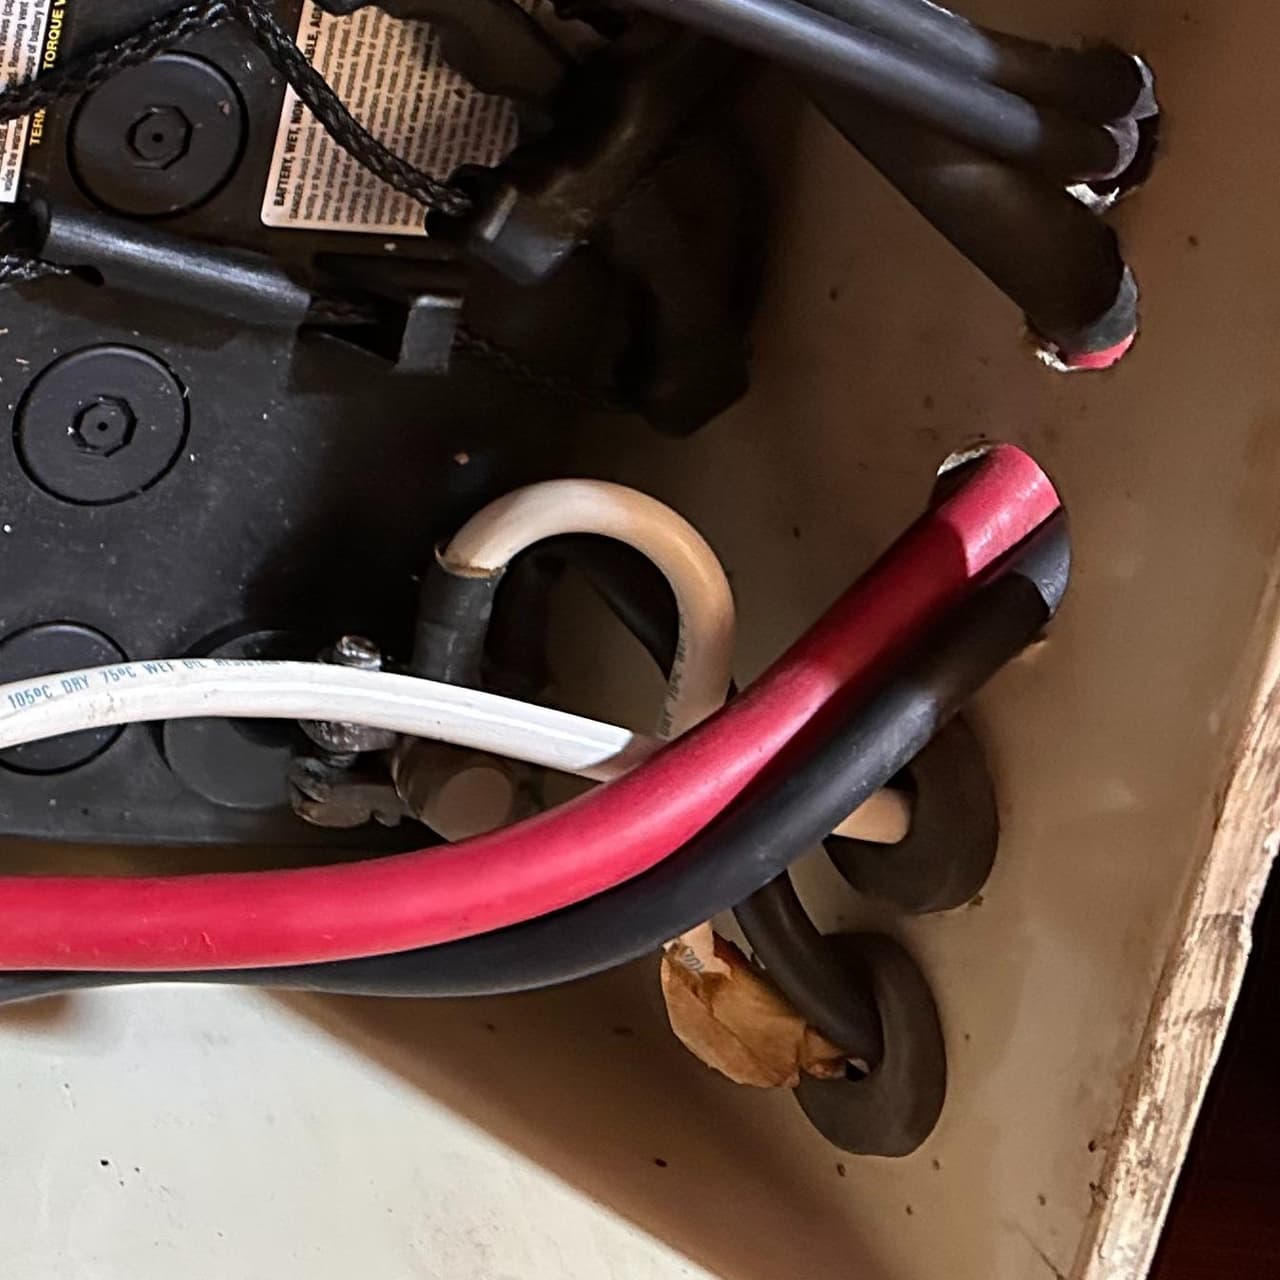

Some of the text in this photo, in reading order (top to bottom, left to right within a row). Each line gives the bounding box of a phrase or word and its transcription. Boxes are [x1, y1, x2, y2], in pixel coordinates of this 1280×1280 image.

[42, 8, 64, 70] TORQUE
[273, 125, 301, 207] BATTERY, WET,
[63, 674, 90, 694] DRY
[142, 660, 178, 675] WET
